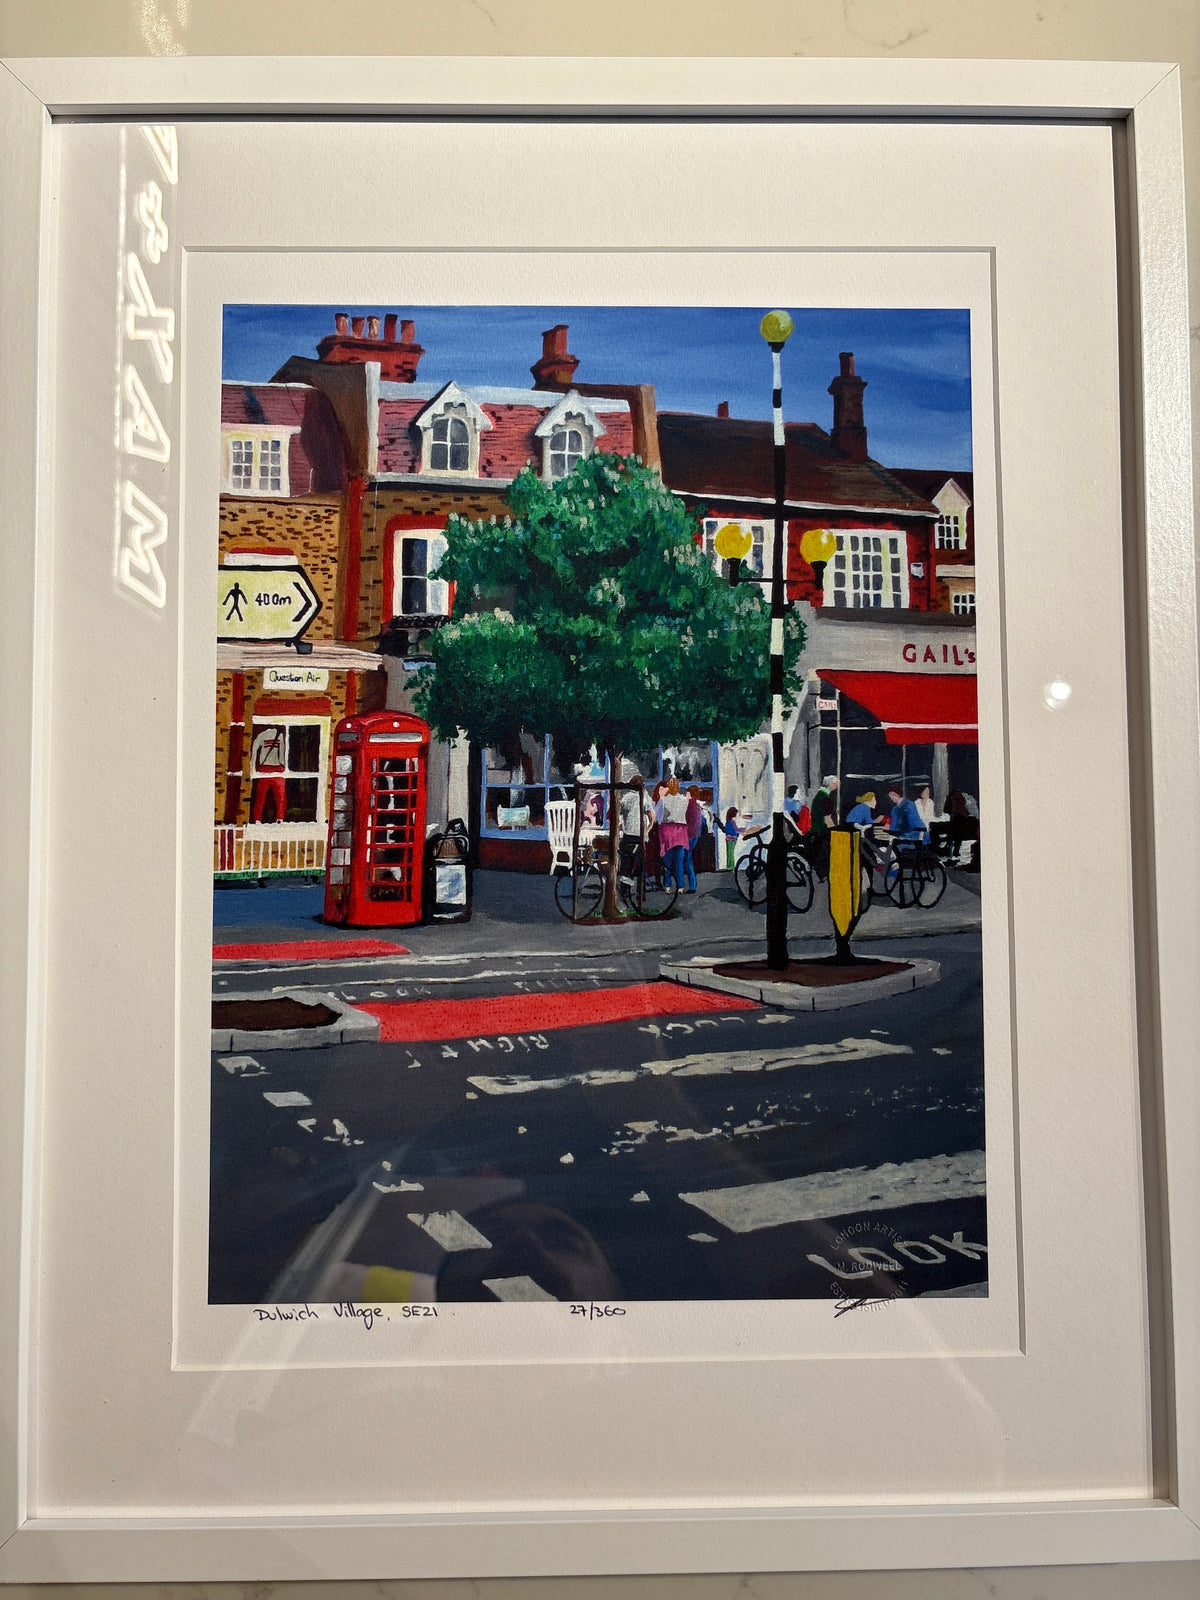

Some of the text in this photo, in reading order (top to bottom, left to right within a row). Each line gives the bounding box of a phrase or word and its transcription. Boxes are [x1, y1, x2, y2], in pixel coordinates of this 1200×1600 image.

[255, 592, 292, 606] 400m
[902, 643, 976, 666] GAIL's
[306, 671, 321, 682] Air
[872, 1222, 907, 1247] ARTIS
[806, 1231, 988, 1280] LOOK
[253, 1304, 319, 1321] Dulwich
[402, 1305, 439, 1318] SE21
[570, 1302, 627, 1320] 27/360
